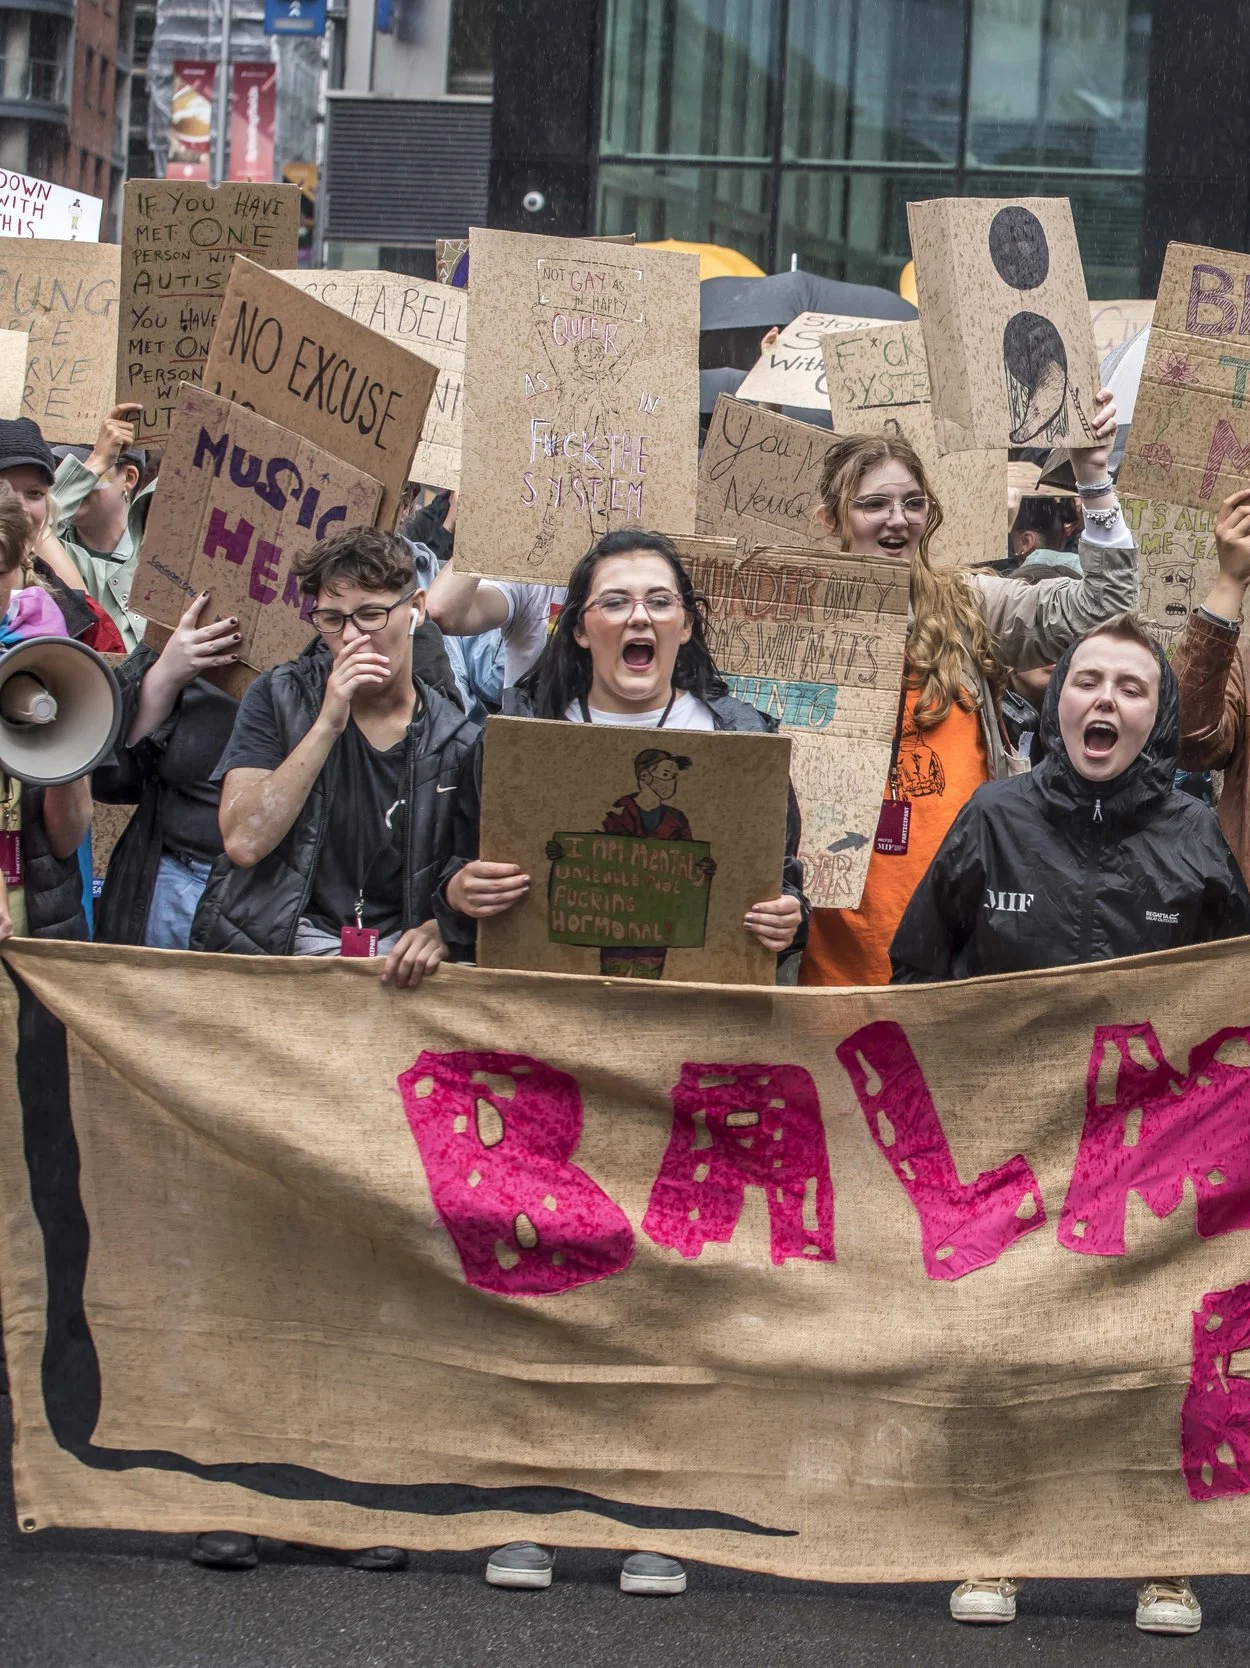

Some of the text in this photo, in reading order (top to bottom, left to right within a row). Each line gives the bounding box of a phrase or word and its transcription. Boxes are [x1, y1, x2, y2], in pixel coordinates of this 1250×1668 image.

[137, 192, 156, 218] IF
[168, 192, 214, 215] YOU
[0, 214, 35, 239] HIS
[136, 218, 276, 248] MET ONE
[134, 250, 250, 266] PERSON WIT
[133, 271, 231, 295] AUTIS
[543, 268, 625, 292] NOT GAY AS
[130, 306, 218, 331] YOU HAVE
[592, 296, 628, 315] HAPPY
[552, 312, 620, 357] QUEER
[129, 339, 166, 358] MET
[128, 363, 203, 387] PERSON
[229, 301, 283, 375] NO
[288, 335, 402, 450] EXCUSE
[525, 372, 549, 396] AS
[842, 371, 931, 406] SYSTE
[604, 433, 651, 475] THE
[709, 406, 793, 481] You
[193, 426, 348, 541] MUSIC
[520, 471, 644, 519] SYSTEM
[1141, 532, 1174, 555] ME
[822, 571, 896, 625] ONLY
[900, 806, 910, 844] PARTICIPANT
[565, 837, 585, 859] I
[592, 838, 624, 864] AM
